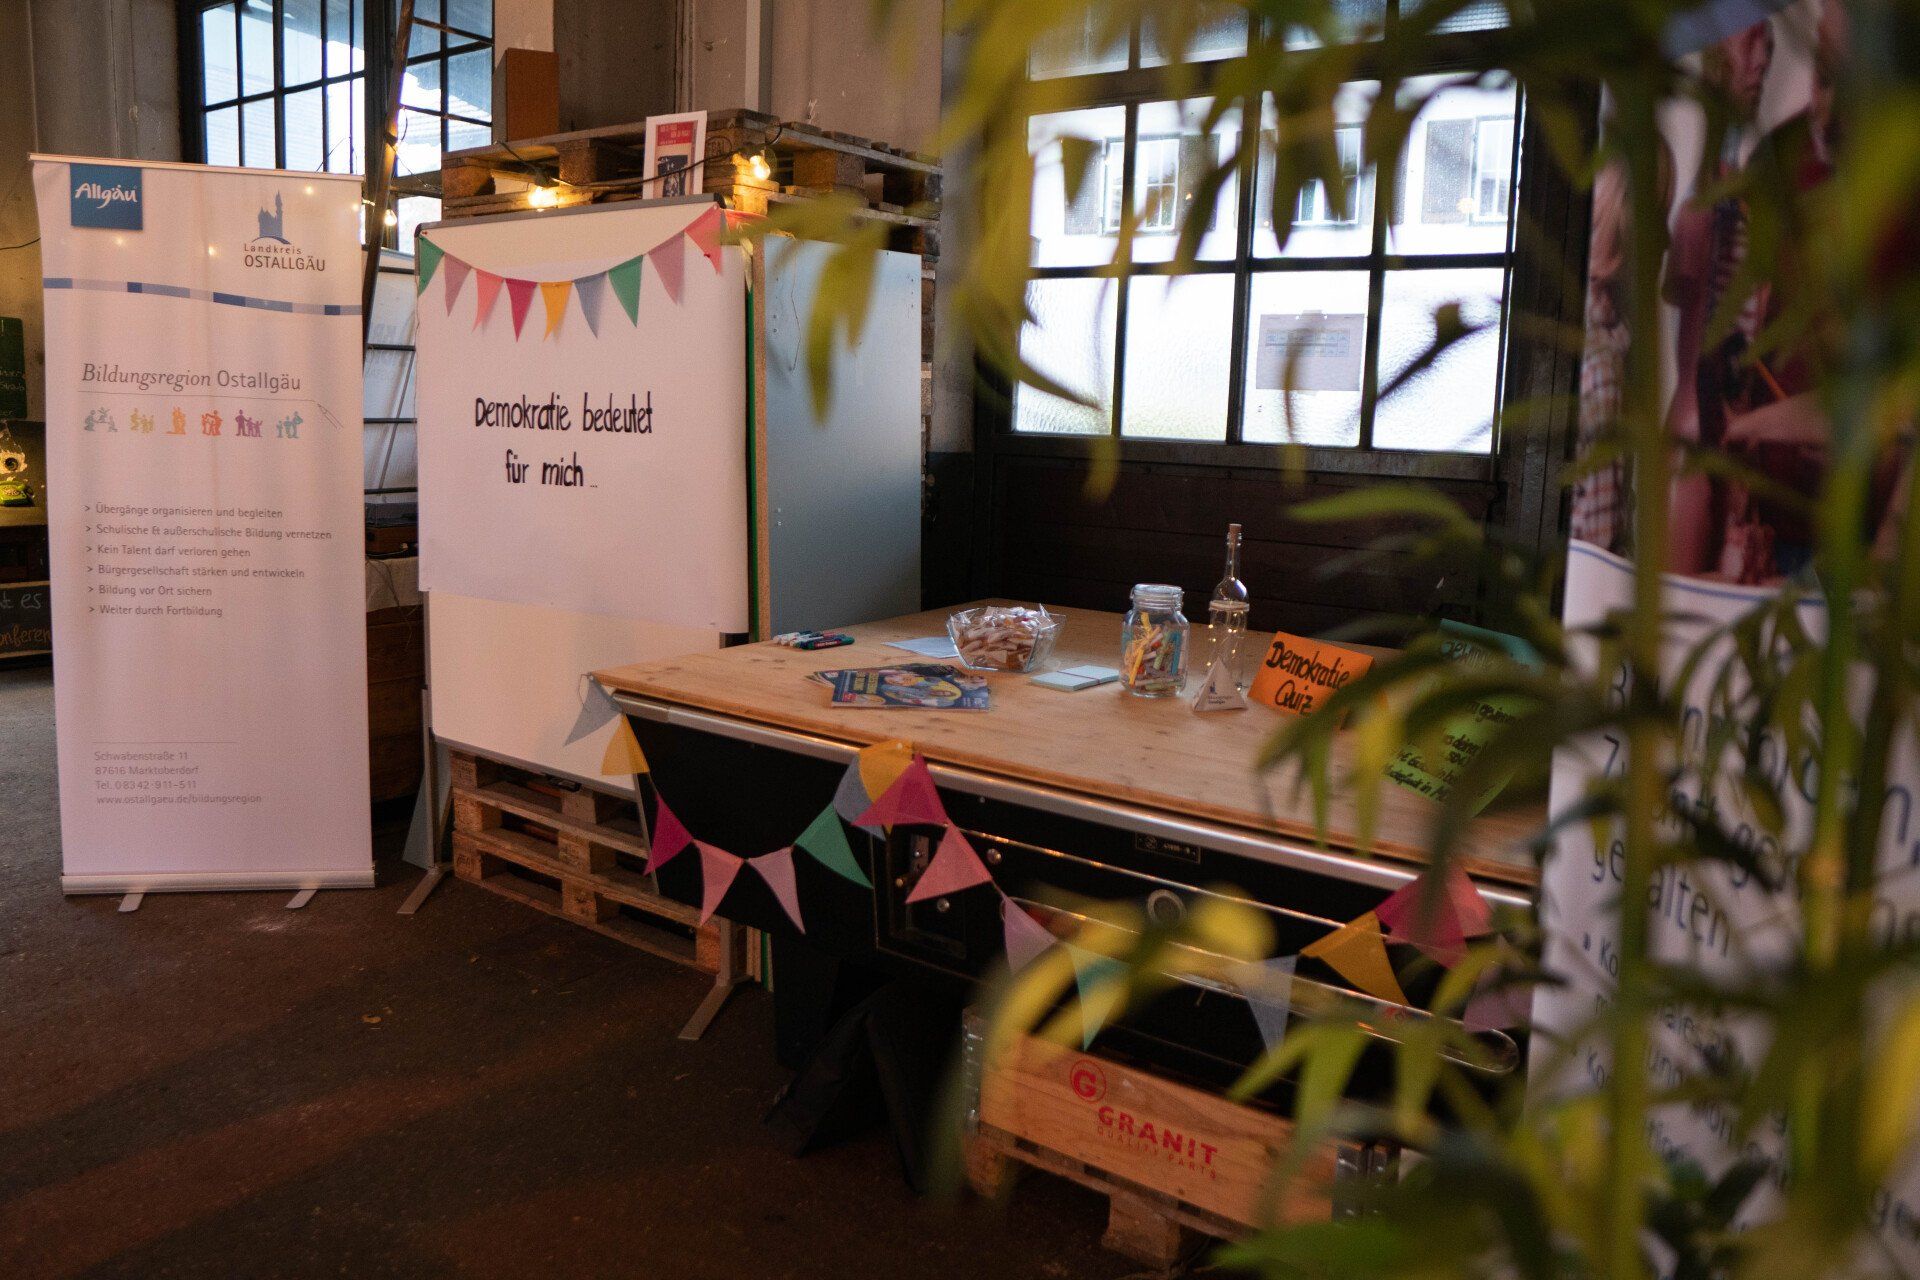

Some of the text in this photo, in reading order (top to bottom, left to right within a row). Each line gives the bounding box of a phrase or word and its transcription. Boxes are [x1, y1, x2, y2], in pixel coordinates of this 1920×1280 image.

[74, 182, 138, 209] Allgäu
[244, 243, 302, 255] Landkreis
[244, 254, 325, 272] OSTALLGÄU
[82, 363, 301, 394] Bildungsregion Ostallgäu
[475, 390, 653, 434] Demokratie bedeutet
[506, 448, 529, 484] für
[541, 451, 584, 487] mich
[95, 502, 283, 519] Übergänge organisieren und begleiten
[96, 525, 149, 536] Schulische
[163, 526, 241, 538] außerschulische
[245, 528, 283, 540] Bildung
[286, 530, 332, 540] vernetzen
[97, 544, 251, 559] Kein Talent darf verloren gehen
[98, 564, 305, 579] Bürgergesellschaft stärken und entwickeln
[98, 584, 212, 597] Bildung vor Ort sichern
[99, 604, 223, 618] Weiter durch Fortbildung
[1266, 640, 1350, 691] Demokratie
[1274, 680, 1314, 714] Quiz
[94, 751, 175, 761] Schwabenstraße
[129, 765, 200, 776] Marktoberdorf
[1098, 1105, 1218, 1166] GRANIT
